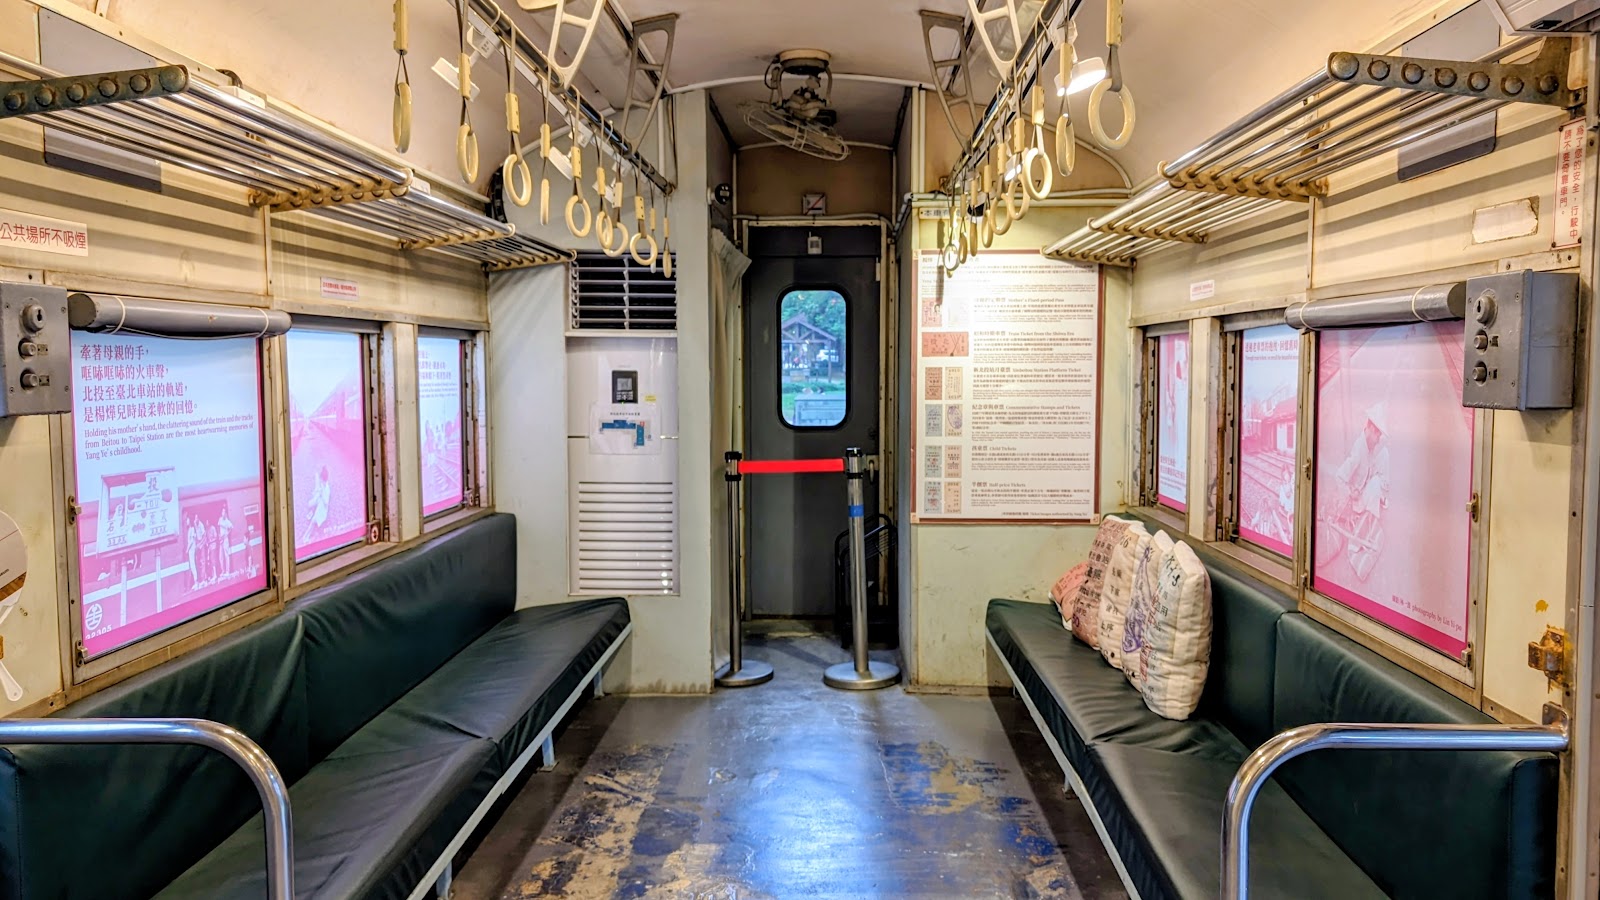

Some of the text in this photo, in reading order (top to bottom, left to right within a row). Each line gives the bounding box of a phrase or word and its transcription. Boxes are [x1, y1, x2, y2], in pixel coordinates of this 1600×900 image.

[0, 222, 87, 249] 公共場所不吸煙
[80, 343, 149, 361] 牽著母親的手，
[82, 381, 188, 402] 北投至臺北車站的軌道，
[83, 400, 197, 423] 是楊燁兒時最柔軟的回憶。
[84, 427, 108, 438] Holding
[108, 426, 117, 435] his
[142, 422, 157, 431] hand,
[157, 421, 165, 430] the
[166, 419, 189, 429] clattering
[190, 417, 203, 426] sound
[203, 416, 209, 425] of
[216, 415, 226, 423] train
[241, 413, 253, 421] tracks
[85, 439, 99, 449] from
[101, 437, 119, 447] Beitou
[121, 436, 128, 445] to
[129, 433, 145, 444] Taipei
[147, 432, 164, 441] Station
[165, 431, 174, 439] are
[185, 429, 196, 437] most
[197, 424, 227, 435] heartwarming
[228, 423, 248, 432] memories
[248, 421, 254, 429] of
[85, 450, 100, 460] Yang
[113, 445, 142, 456] childhood.
[1412, 604, 1436, 620] photography
[1436, 614, 1442, 624] by
